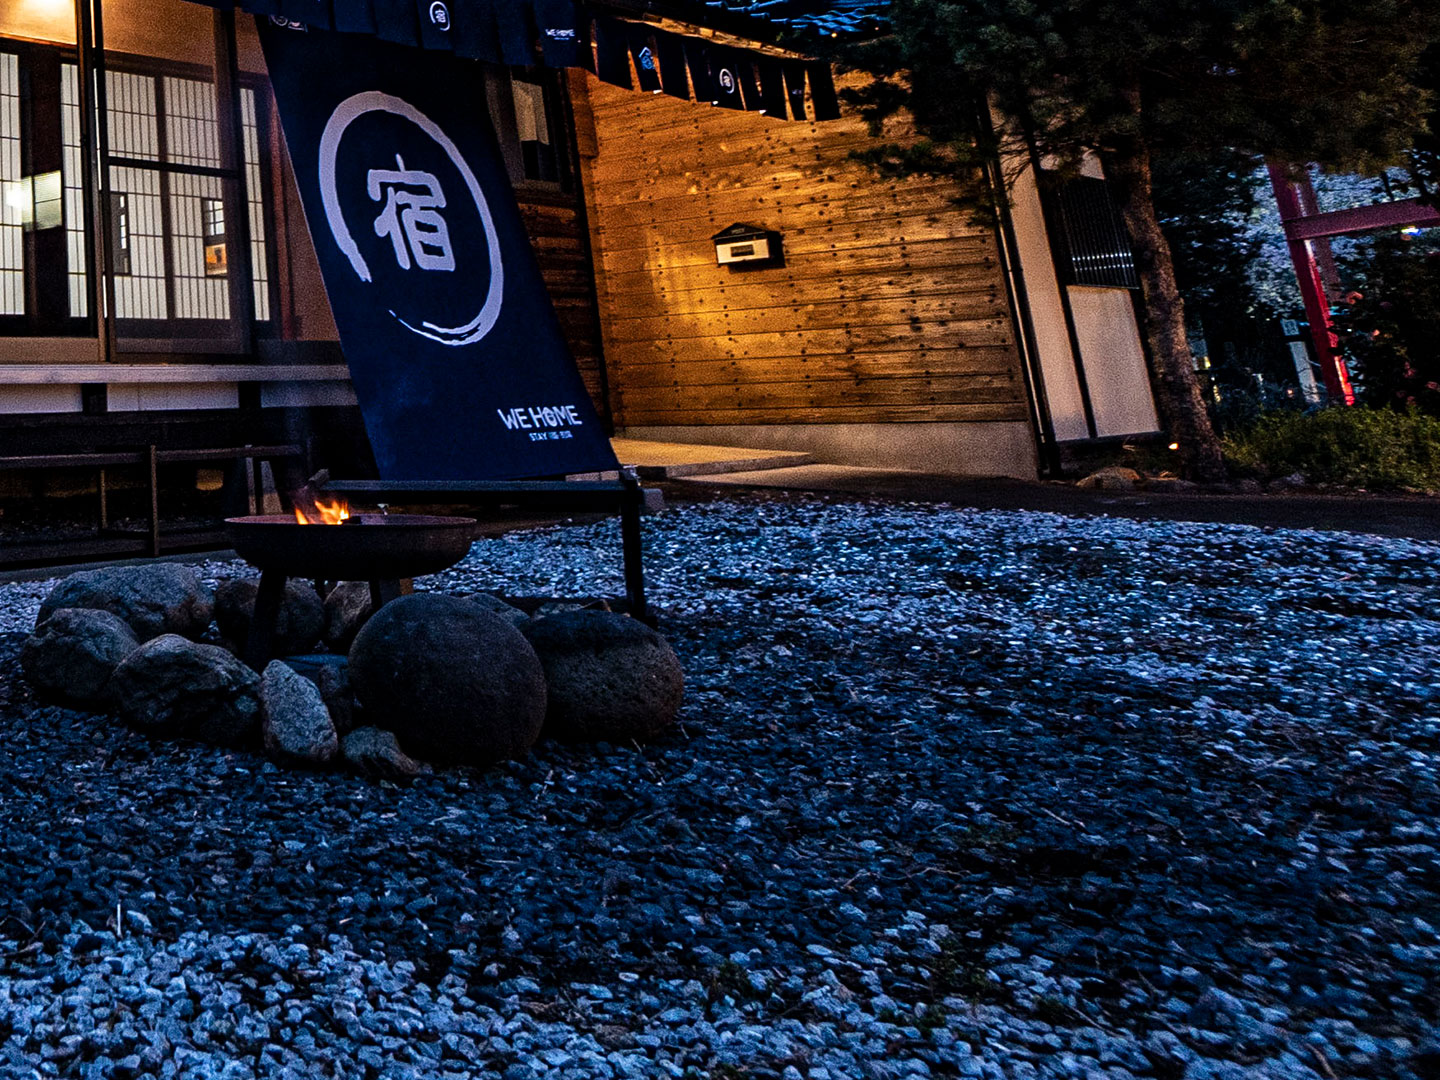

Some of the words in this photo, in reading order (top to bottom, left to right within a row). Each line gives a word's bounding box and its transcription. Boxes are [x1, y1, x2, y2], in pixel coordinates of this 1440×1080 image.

[367, 153, 456, 272] 宿
[497, 407, 532, 430] WE
[528, 405, 583, 428] HOME
[529, 432, 548, 441] STAY
